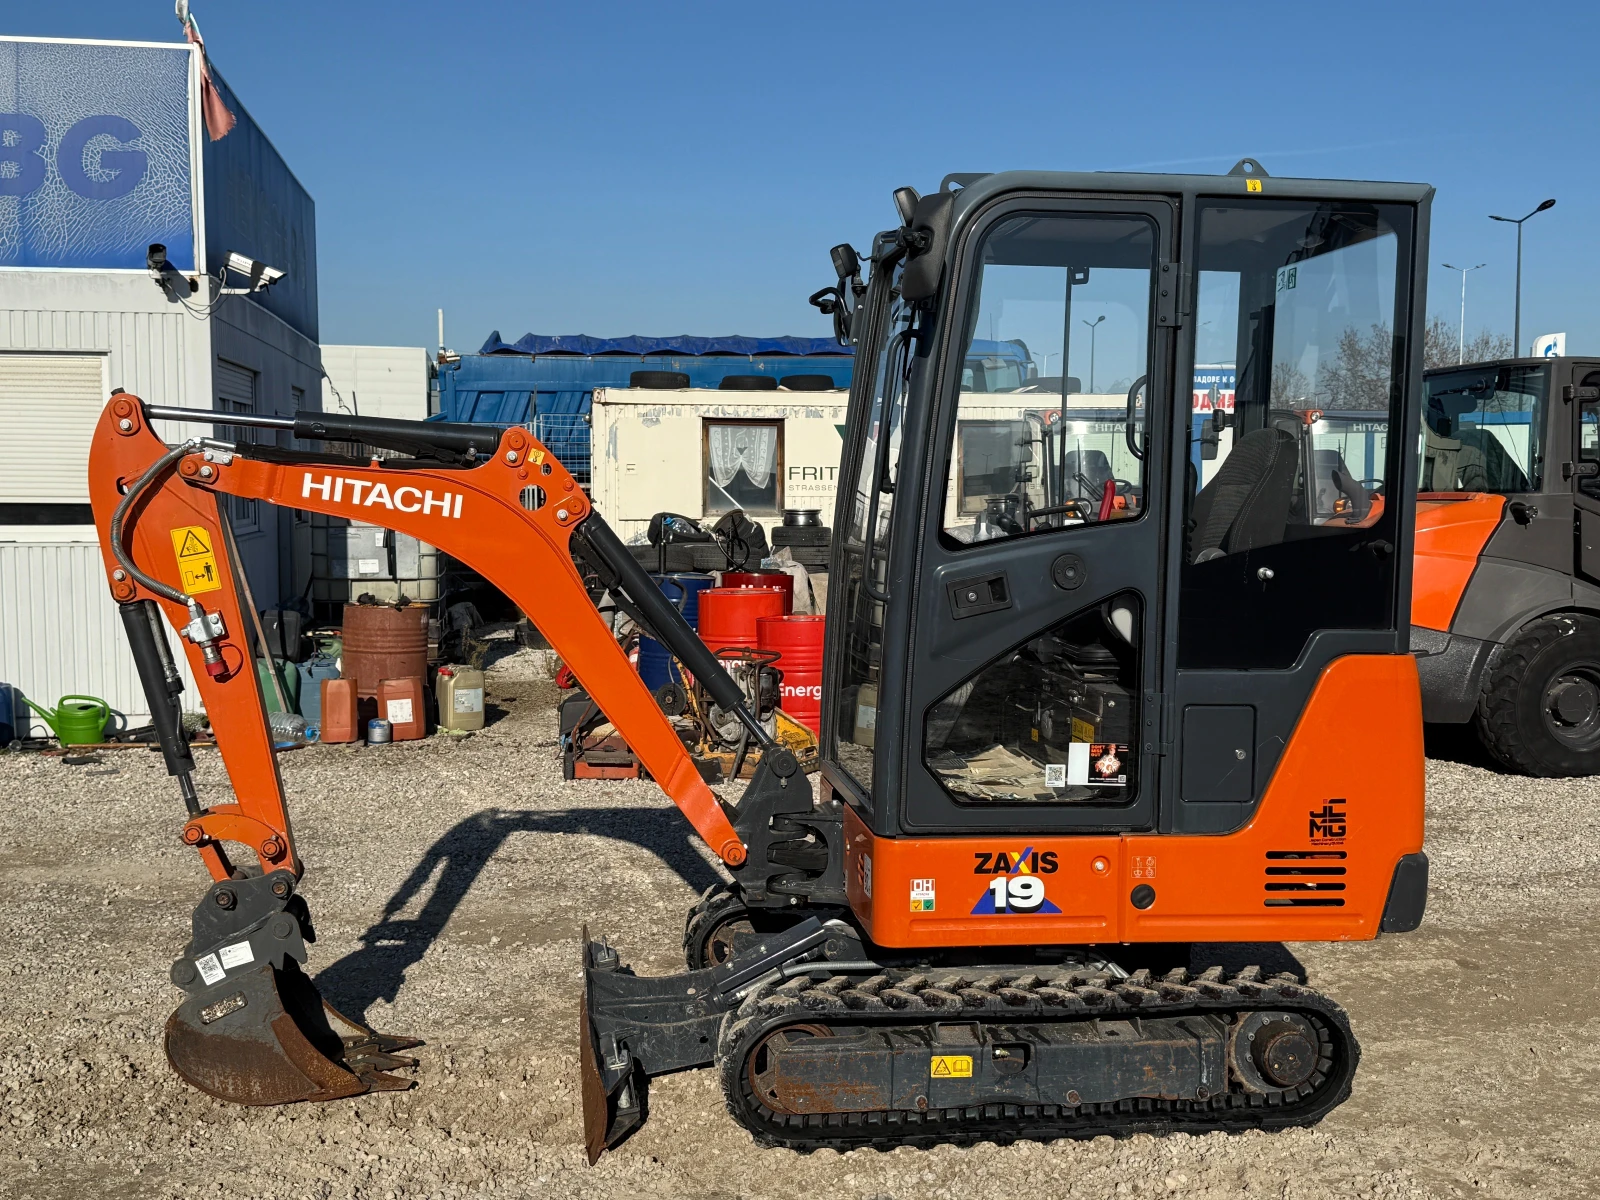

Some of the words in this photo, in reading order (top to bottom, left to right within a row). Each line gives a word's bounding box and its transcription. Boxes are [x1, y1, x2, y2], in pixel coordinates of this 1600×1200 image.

[0, 113, 147, 200] BG
[788, 466, 838, 480] FRIT
[301, 472, 463, 519] HITACHI
[974, 846, 1059, 874] ZAXIS
[990, 875, 1045, 914] 19
